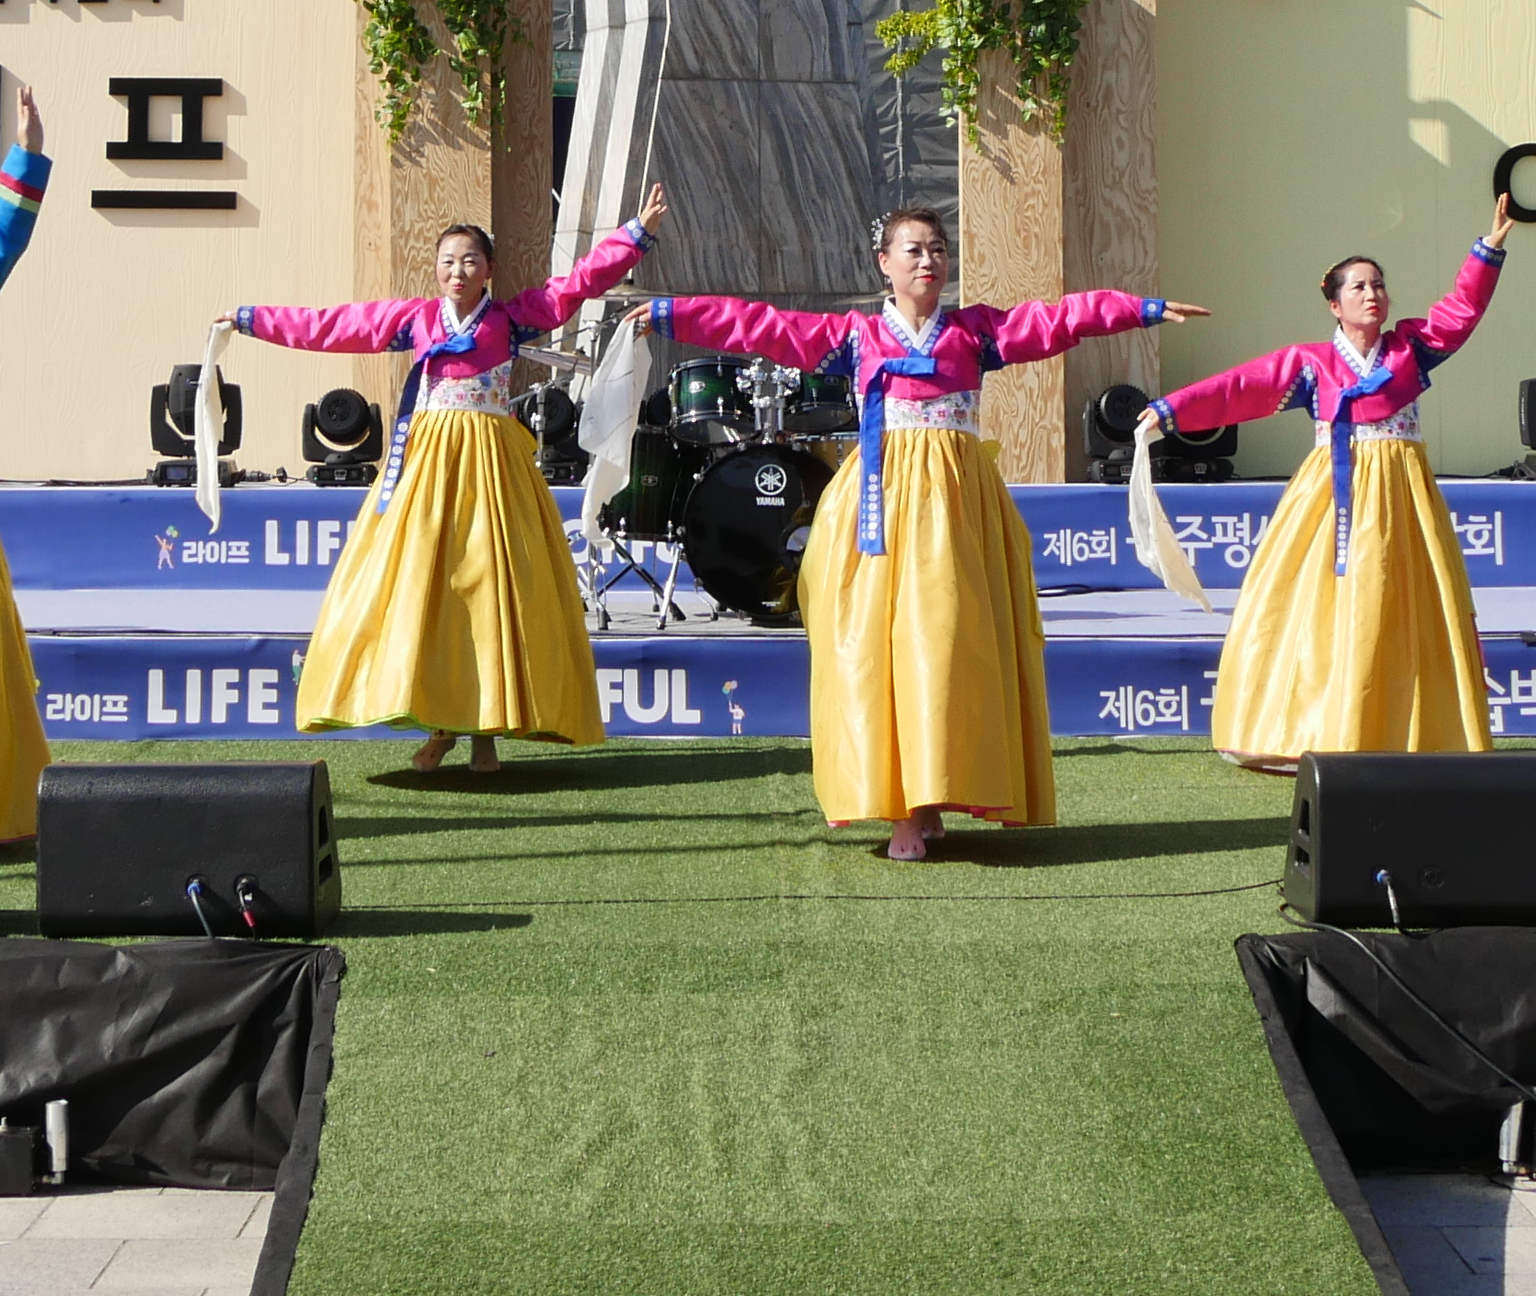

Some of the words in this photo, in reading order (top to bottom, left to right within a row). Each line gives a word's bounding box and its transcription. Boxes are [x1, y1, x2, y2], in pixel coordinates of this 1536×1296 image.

[756, 497, 785, 506] YAMAHA
[182, 541, 250, 565] 라이프
[1042, 527, 1117, 567] 제6회
[46, 693, 128, 723] 라이프
[147, 668, 280, 724] LIFE
[598, 668, 701, 725] FUL
[1099, 686, 1189, 731] 제6회
